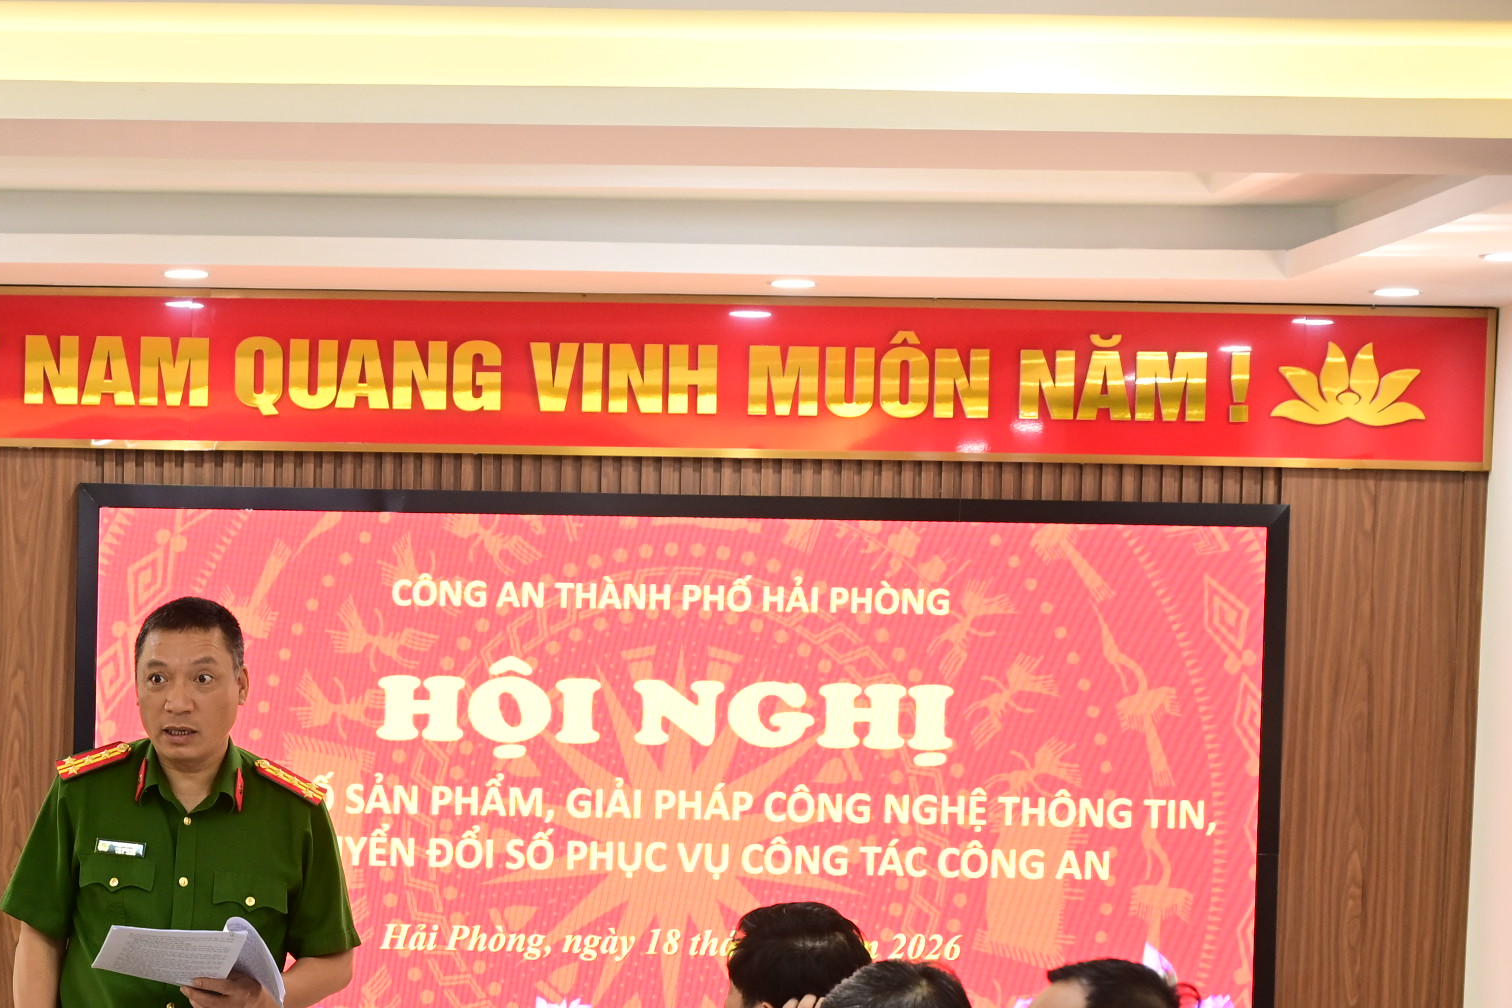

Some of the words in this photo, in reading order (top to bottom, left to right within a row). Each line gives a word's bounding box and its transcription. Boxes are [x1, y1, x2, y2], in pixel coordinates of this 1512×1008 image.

[24, 335, 209, 407] NAM
[234, 336, 502, 416] QUANG
[528, 342, 718, 415] VINH
[747, 331, 991, 419] MUÔN
[391, 573, 487, 607] CÔNG
[496, 581, 544, 609] AN
[554, 577, 671, 611] THÀNH
[682, 575, 752, 612] PHỐ
[763, 576, 818, 613] HẢI
[831, 581, 951, 616] PHÒNG
[376, 656, 601, 759] HỘI
[633, 679, 955, 767] NGHỊ
[345, 773, 419, 816] SẢN
[431, 773, 555, 823] PHẨM,
[566, 778, 648, 820] GIẢI
[655, 783, 753, 822] PHÁP
[764, 784, 871, 824] CÔNG
[883, 787, 987, 832] NGHỆ
[998, 789, 1133, 828] THÔNG
[1144, 798, 1217, 836] TIN,
[337, 824, 415, 868] YỂN
[426, 825, 494, 869] ĐỔI
[505, 828, 555, 871] SỐ
[566, 841, 667, 879] PHỤC
[677, 843, 729, 880] VỤ
[741, 836, 848, 876] CÔNG
[860, 839, 927, 877] TÁC
[937, 840, 1045, 880] CÔNG
[1055, 849, 1110, 881] AN
[380, 923, 437, 952] Hải
[447, 924, 552, 959] Phòng,
[562, 926, 636, 962] ngày
[645, 928, 681, 956] 18
[888, 933, 963, 961] 2026
